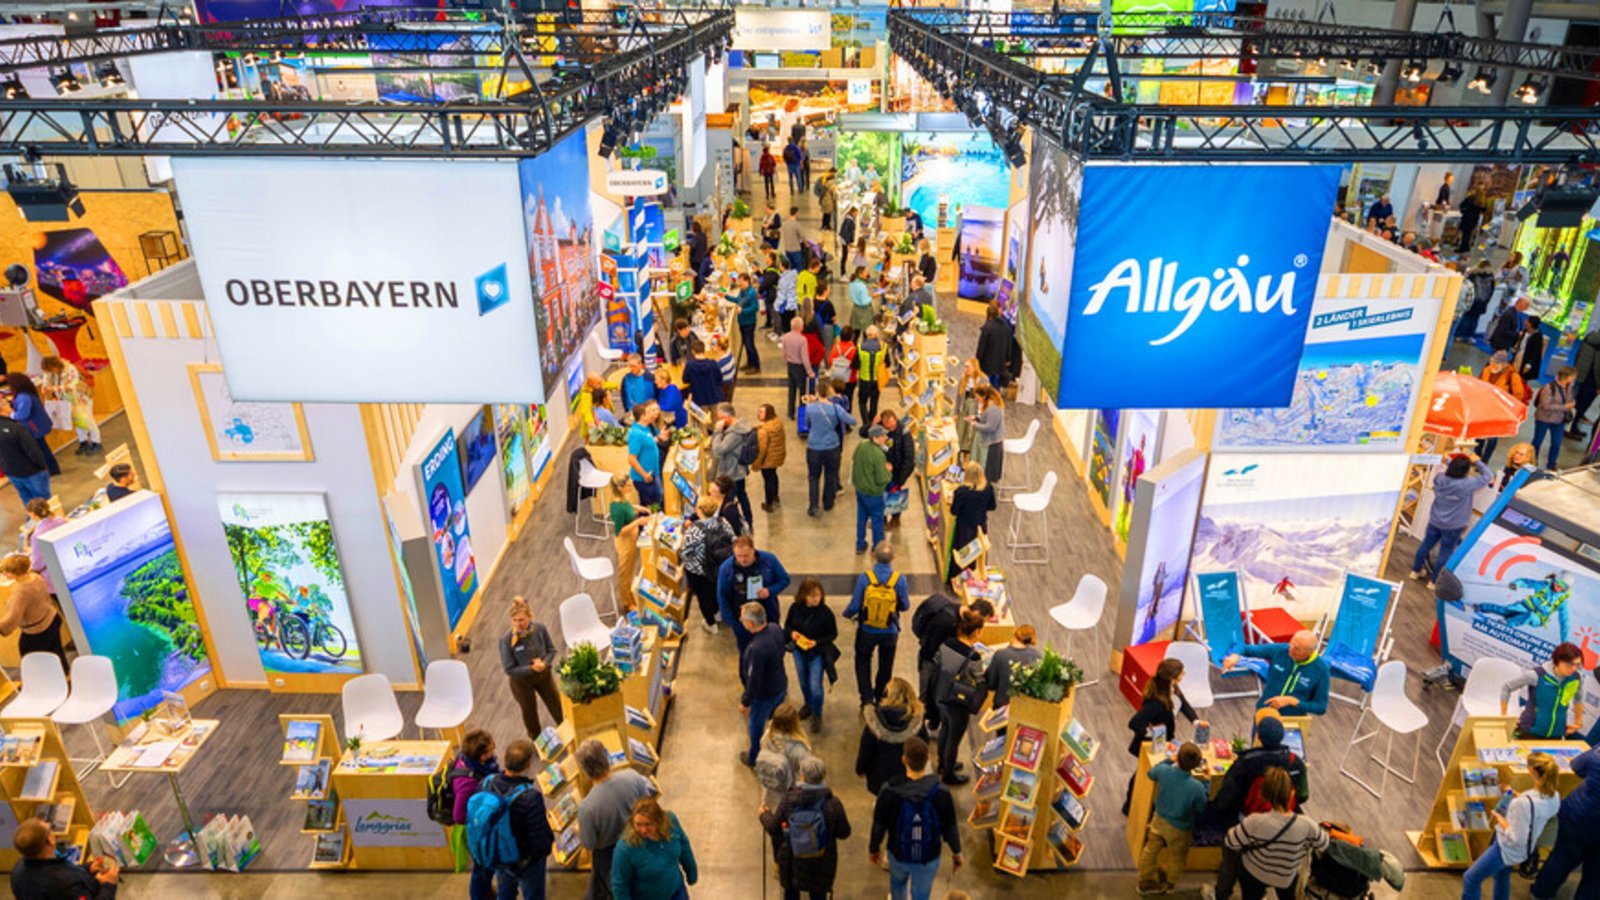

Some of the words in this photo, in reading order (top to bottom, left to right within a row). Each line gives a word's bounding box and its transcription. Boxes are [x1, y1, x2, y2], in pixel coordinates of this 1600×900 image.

[608, 179, 652, 187] OBERBAYERN
[225, 278, 459, 308] OBERBAYERN
[1082, 254, 1297, 346] Allgäu
[1315, 317, 1323, 326] 2
[1324, 309, 1364, 324] LÄNDER
[1358, 310, 1411, 327] SKIERLEBNIS
[425, 435, 454, 481] ERDING
[1474, 622, 1488, 633] AM
[1488, 628, 1532, 651] AUTOMAT
[1514, 630, 1542, 648] ONLINE
[355, 815, 412, 835] Lenggries
